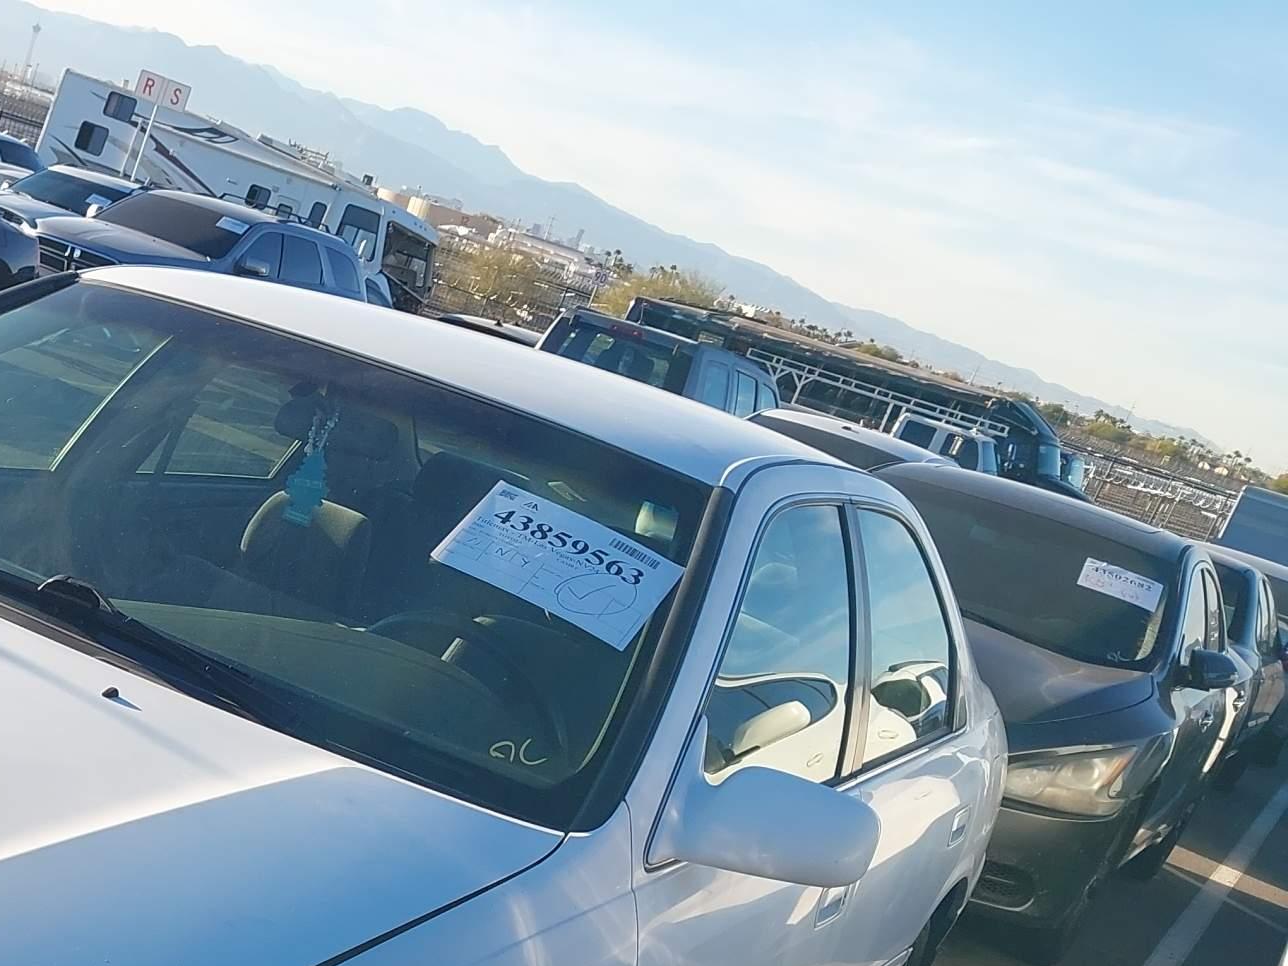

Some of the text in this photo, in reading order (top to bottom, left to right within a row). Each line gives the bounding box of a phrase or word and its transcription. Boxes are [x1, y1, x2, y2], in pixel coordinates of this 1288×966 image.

[143, 77, 182, 105] R S
[595, 271, 608, 284] 90
[493, 510, 645, 586] 43859563
